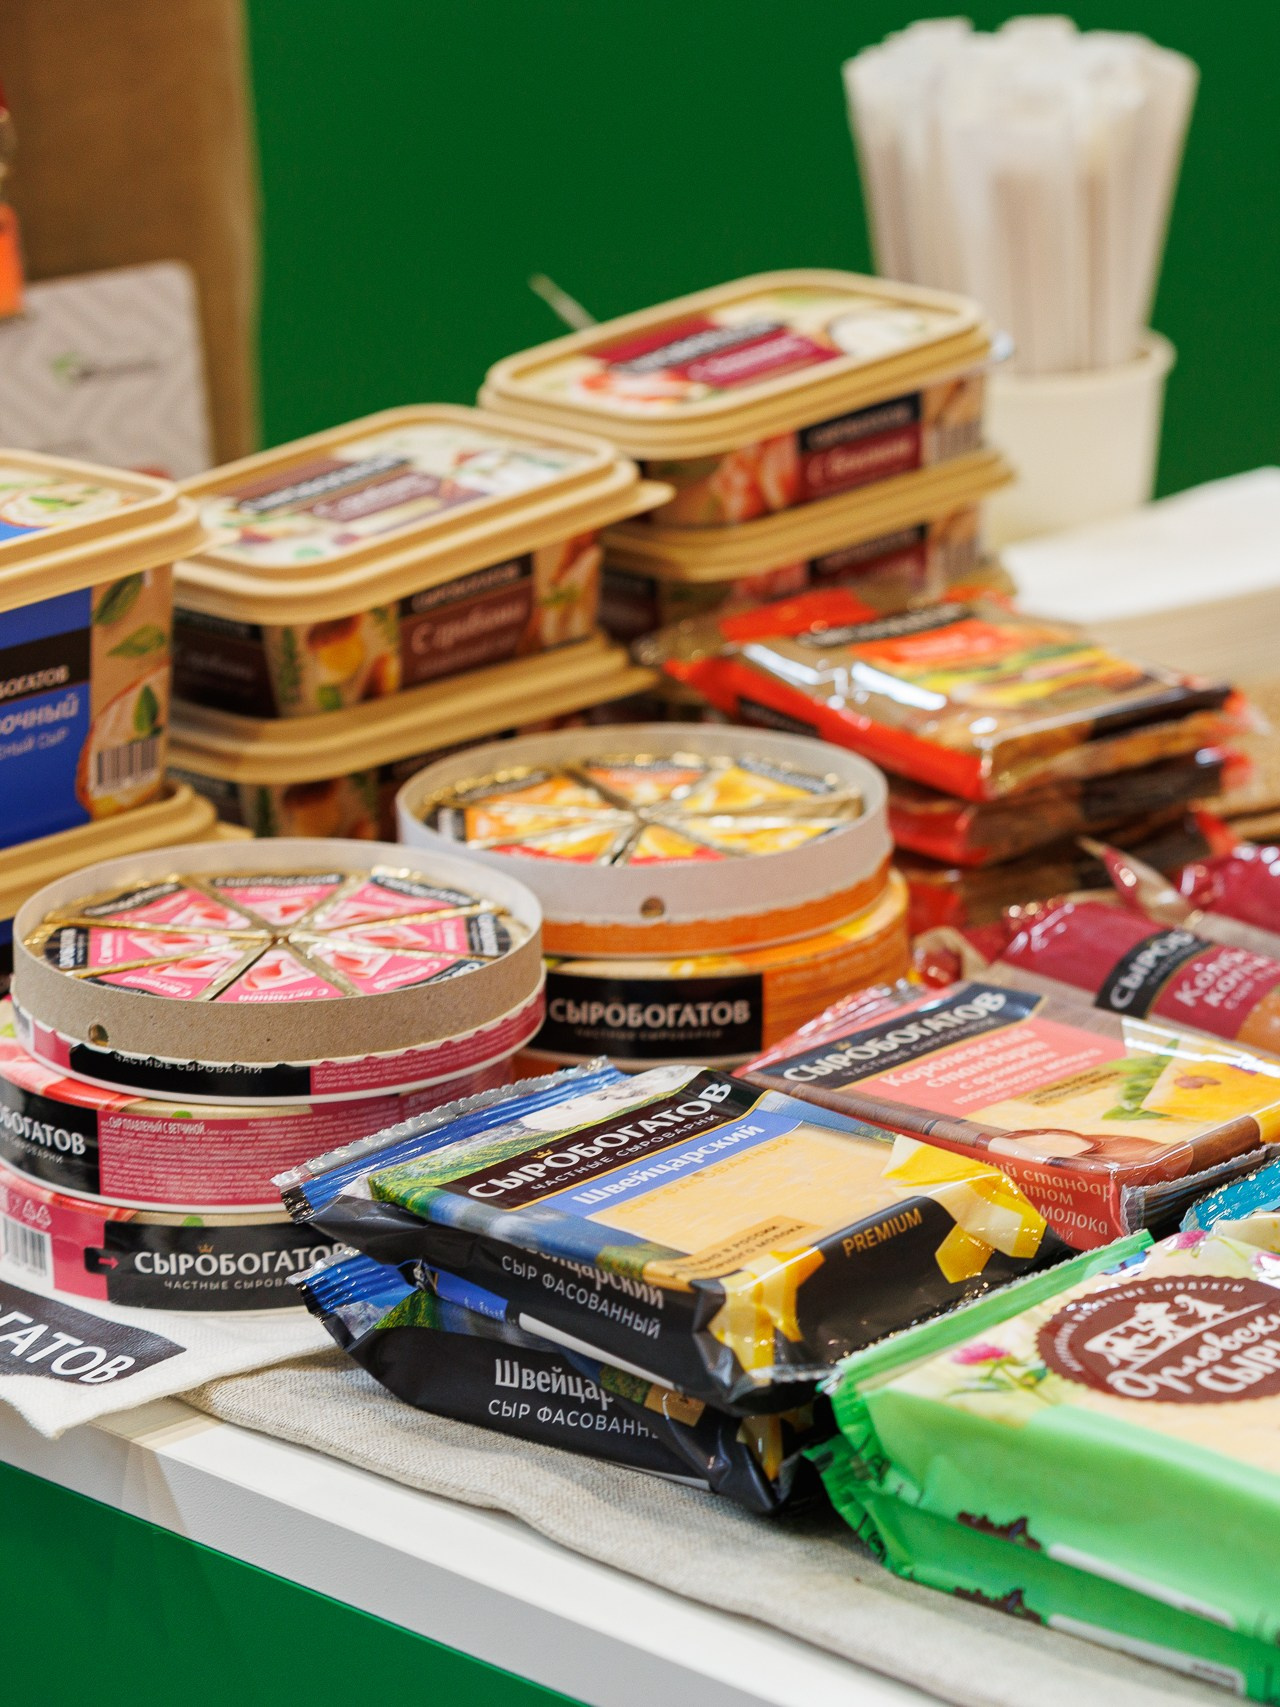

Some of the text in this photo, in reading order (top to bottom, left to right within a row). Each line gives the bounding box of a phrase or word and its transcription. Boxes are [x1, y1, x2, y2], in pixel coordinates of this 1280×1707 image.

[0, 692, 80, 735] очный
[550, 997, 751, 1028] СЫРОБОГАТОВ
[783, 992, 1007, 1083] СЫРОБОГАТОВ
[0, 1105, 86, 1155] БОГАТОВ
[468, 1082, 732, 1198] СЫРОБОГАТОВ
[531, 1114, 720, 1191] ЧАСТНЫЕ СЫРОВАРНИ
[572, 1124, 765, 1205] Швейцарский
[1023, 1169, 1112, 1202] стандар
[1018, 1182, 1073, 1206] атом
[841, 1207, 923, 1257] PREMIUM
[1039, 1204, 1108, 1235] молока
[164, 1279, 229, 1291] ЧАСТНЫЕ
[502, 1255, 537, 1281] СЫР
[541, 1273, 662, 1340] ФАСОВАННЫЙ
[1153, 1281, 1246, 1294] ПРОДУКТЫ
[0, 1304, 136, 1384] ГАТОВ
[494, 1358, 615, 1411] Швейцар
[488, 1399, 659, 1439] СЫР ФАСОВАНН
